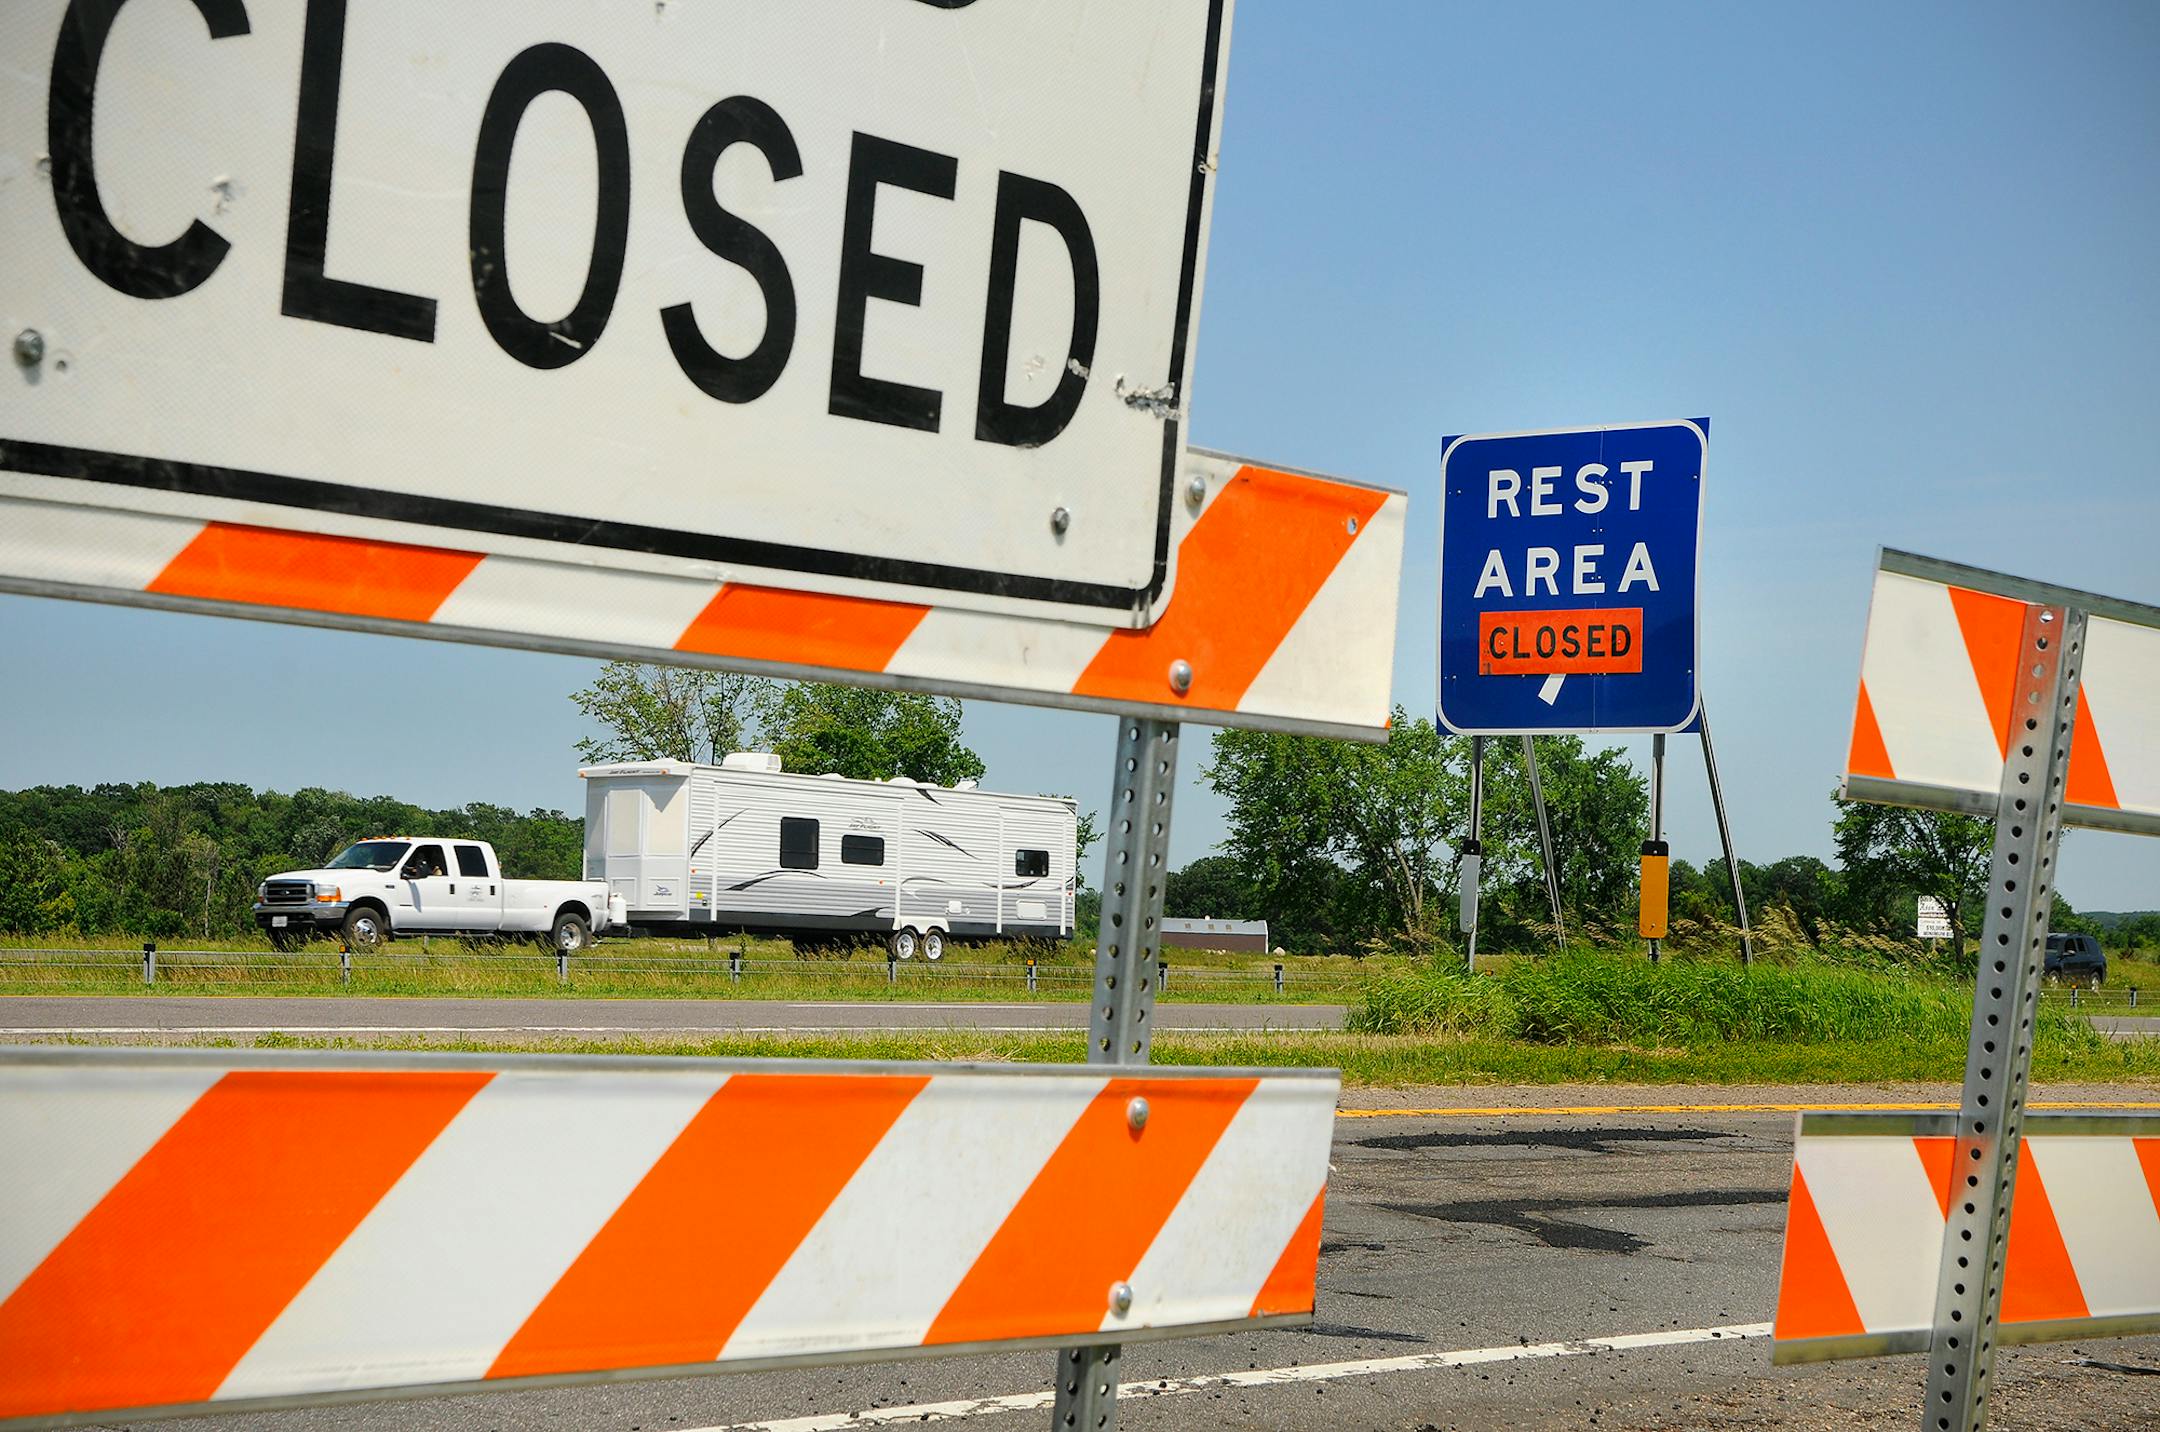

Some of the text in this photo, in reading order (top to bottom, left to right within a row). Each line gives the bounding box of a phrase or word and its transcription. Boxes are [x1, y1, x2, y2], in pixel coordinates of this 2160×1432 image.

[48, 0, 1101, 448] CLOSED
[1487, 460, 1653, 518] REST
[1473, 542, 1660, 599] AREA
[1488, 624, 1632, 660] CLOSED
